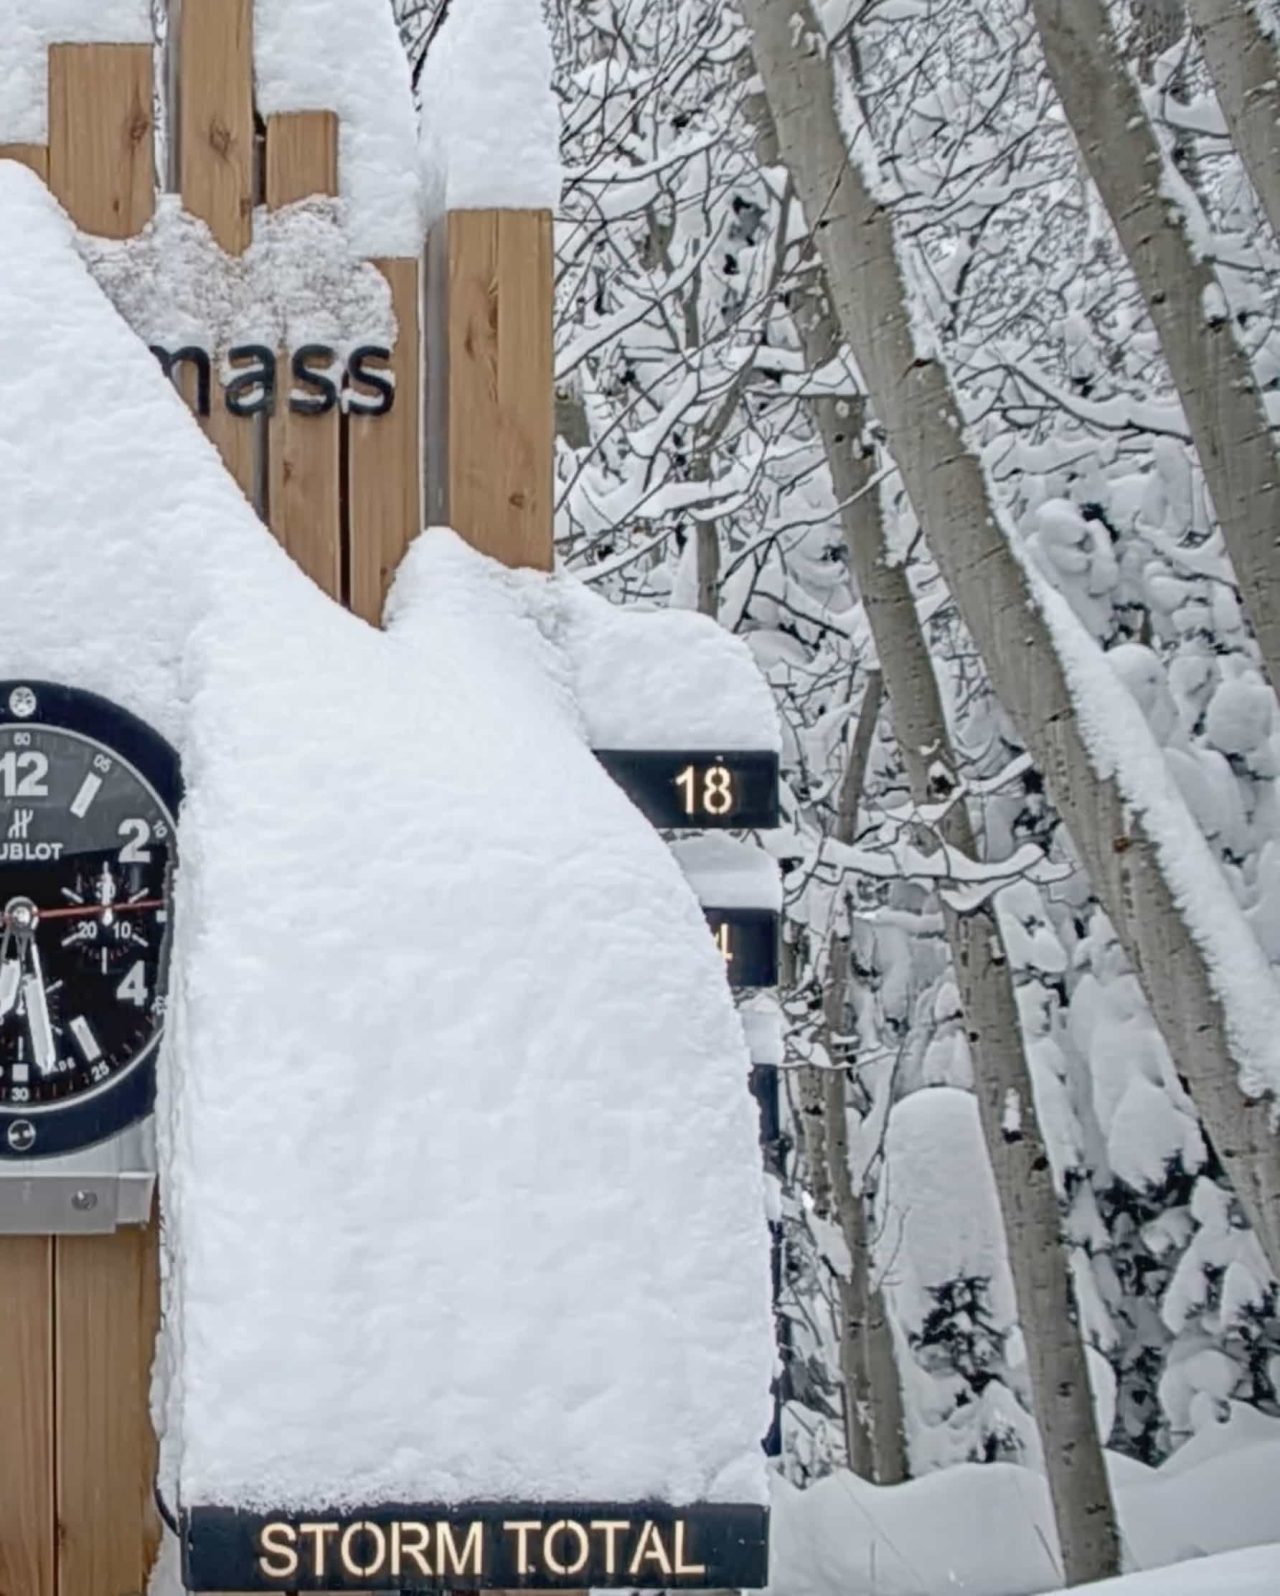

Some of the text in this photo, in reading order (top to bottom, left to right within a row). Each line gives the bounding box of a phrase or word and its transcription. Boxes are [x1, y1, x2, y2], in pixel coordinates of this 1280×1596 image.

[13, 732, 31, 746] 60
[93, 753, 112, 773] 05
[675, 765, 732, 815] 18
[117, 818, 151, 863] 2
[77, 921, 98, 939] 20
[112, 921, 131, 939] 10
[116, 960, 148, 1006] 4
[91, 1061, 110, 1082] 25
[11, 1087, 29, 1101] 30
[259, 1520, 705, 1577] STORM TOTAL
